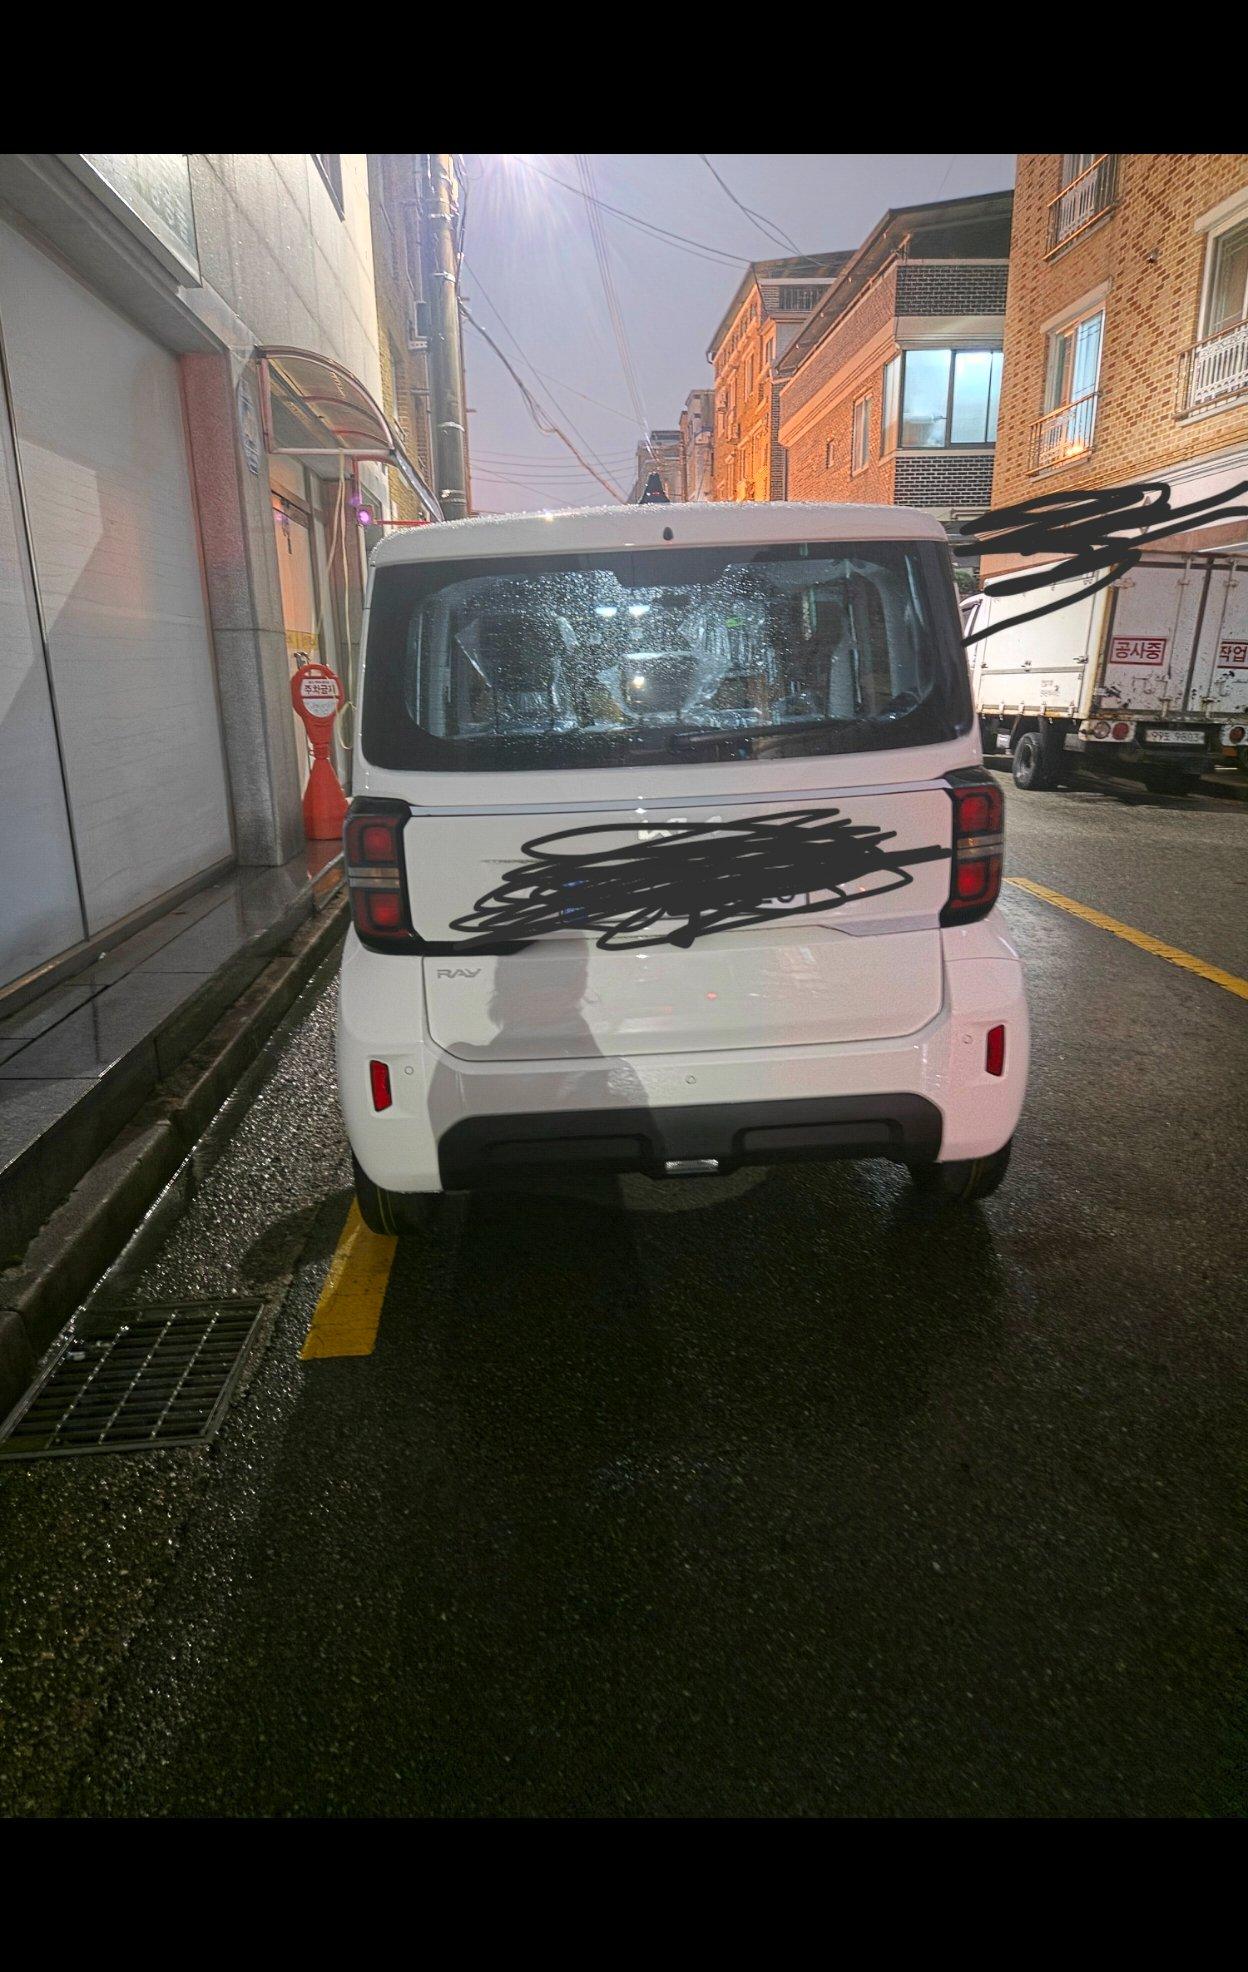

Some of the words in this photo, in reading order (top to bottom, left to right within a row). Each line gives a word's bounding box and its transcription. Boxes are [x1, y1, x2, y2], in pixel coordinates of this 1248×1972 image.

[1115, 641, 1162, 660] 공사중
[1218, 645, 1248, 663] 작업
[304, 684, 336, 695] 주차금지
[437, 968, 482, 979] RAY
